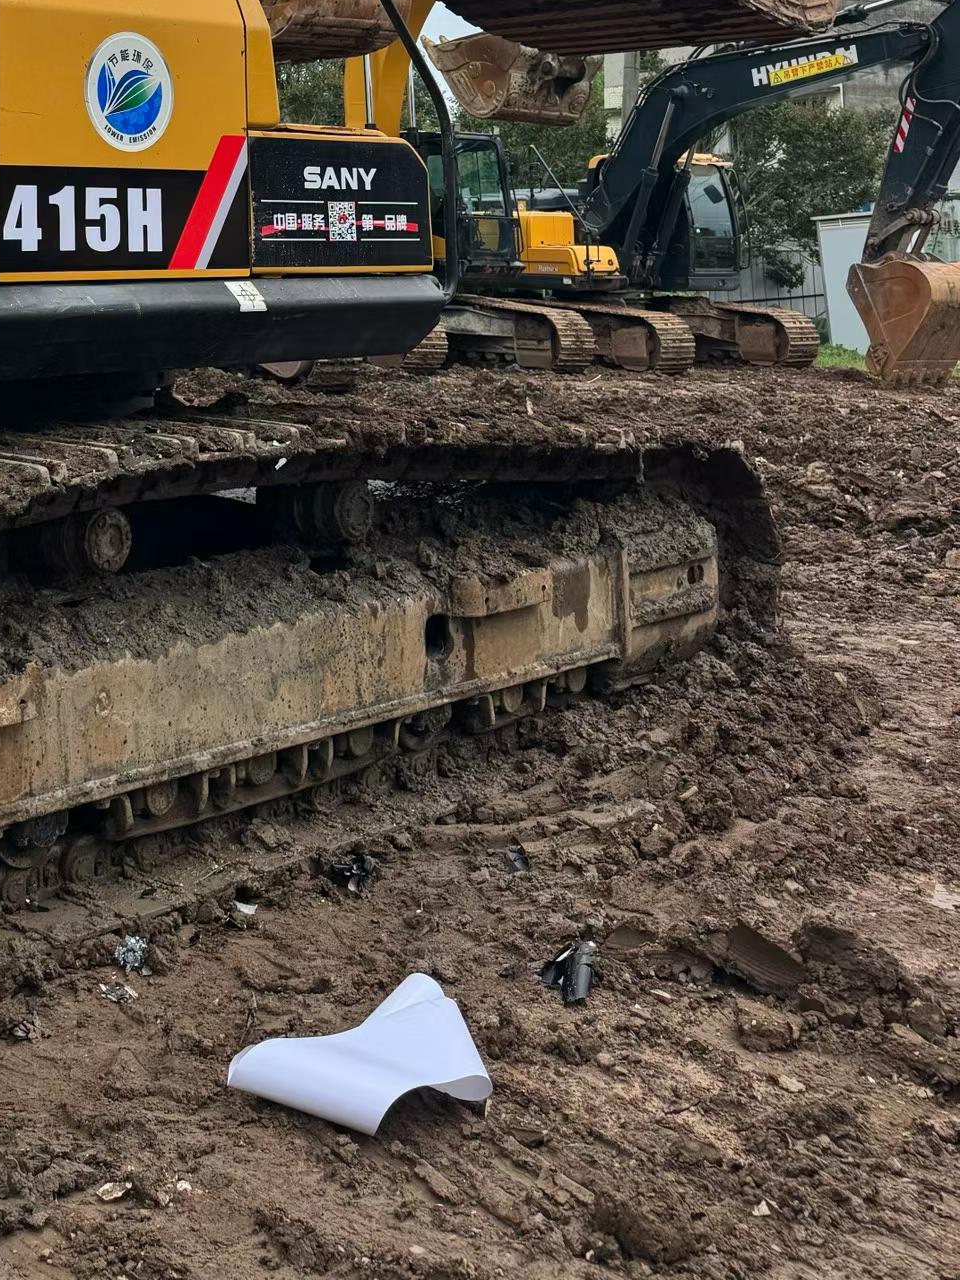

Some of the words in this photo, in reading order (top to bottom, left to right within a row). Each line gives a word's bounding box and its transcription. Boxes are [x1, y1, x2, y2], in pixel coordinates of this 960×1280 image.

[104, 124, 124, 142] LOWER
[129, 125, 157, 144] EMISSION
[303, 166, 377, 191] SANY
